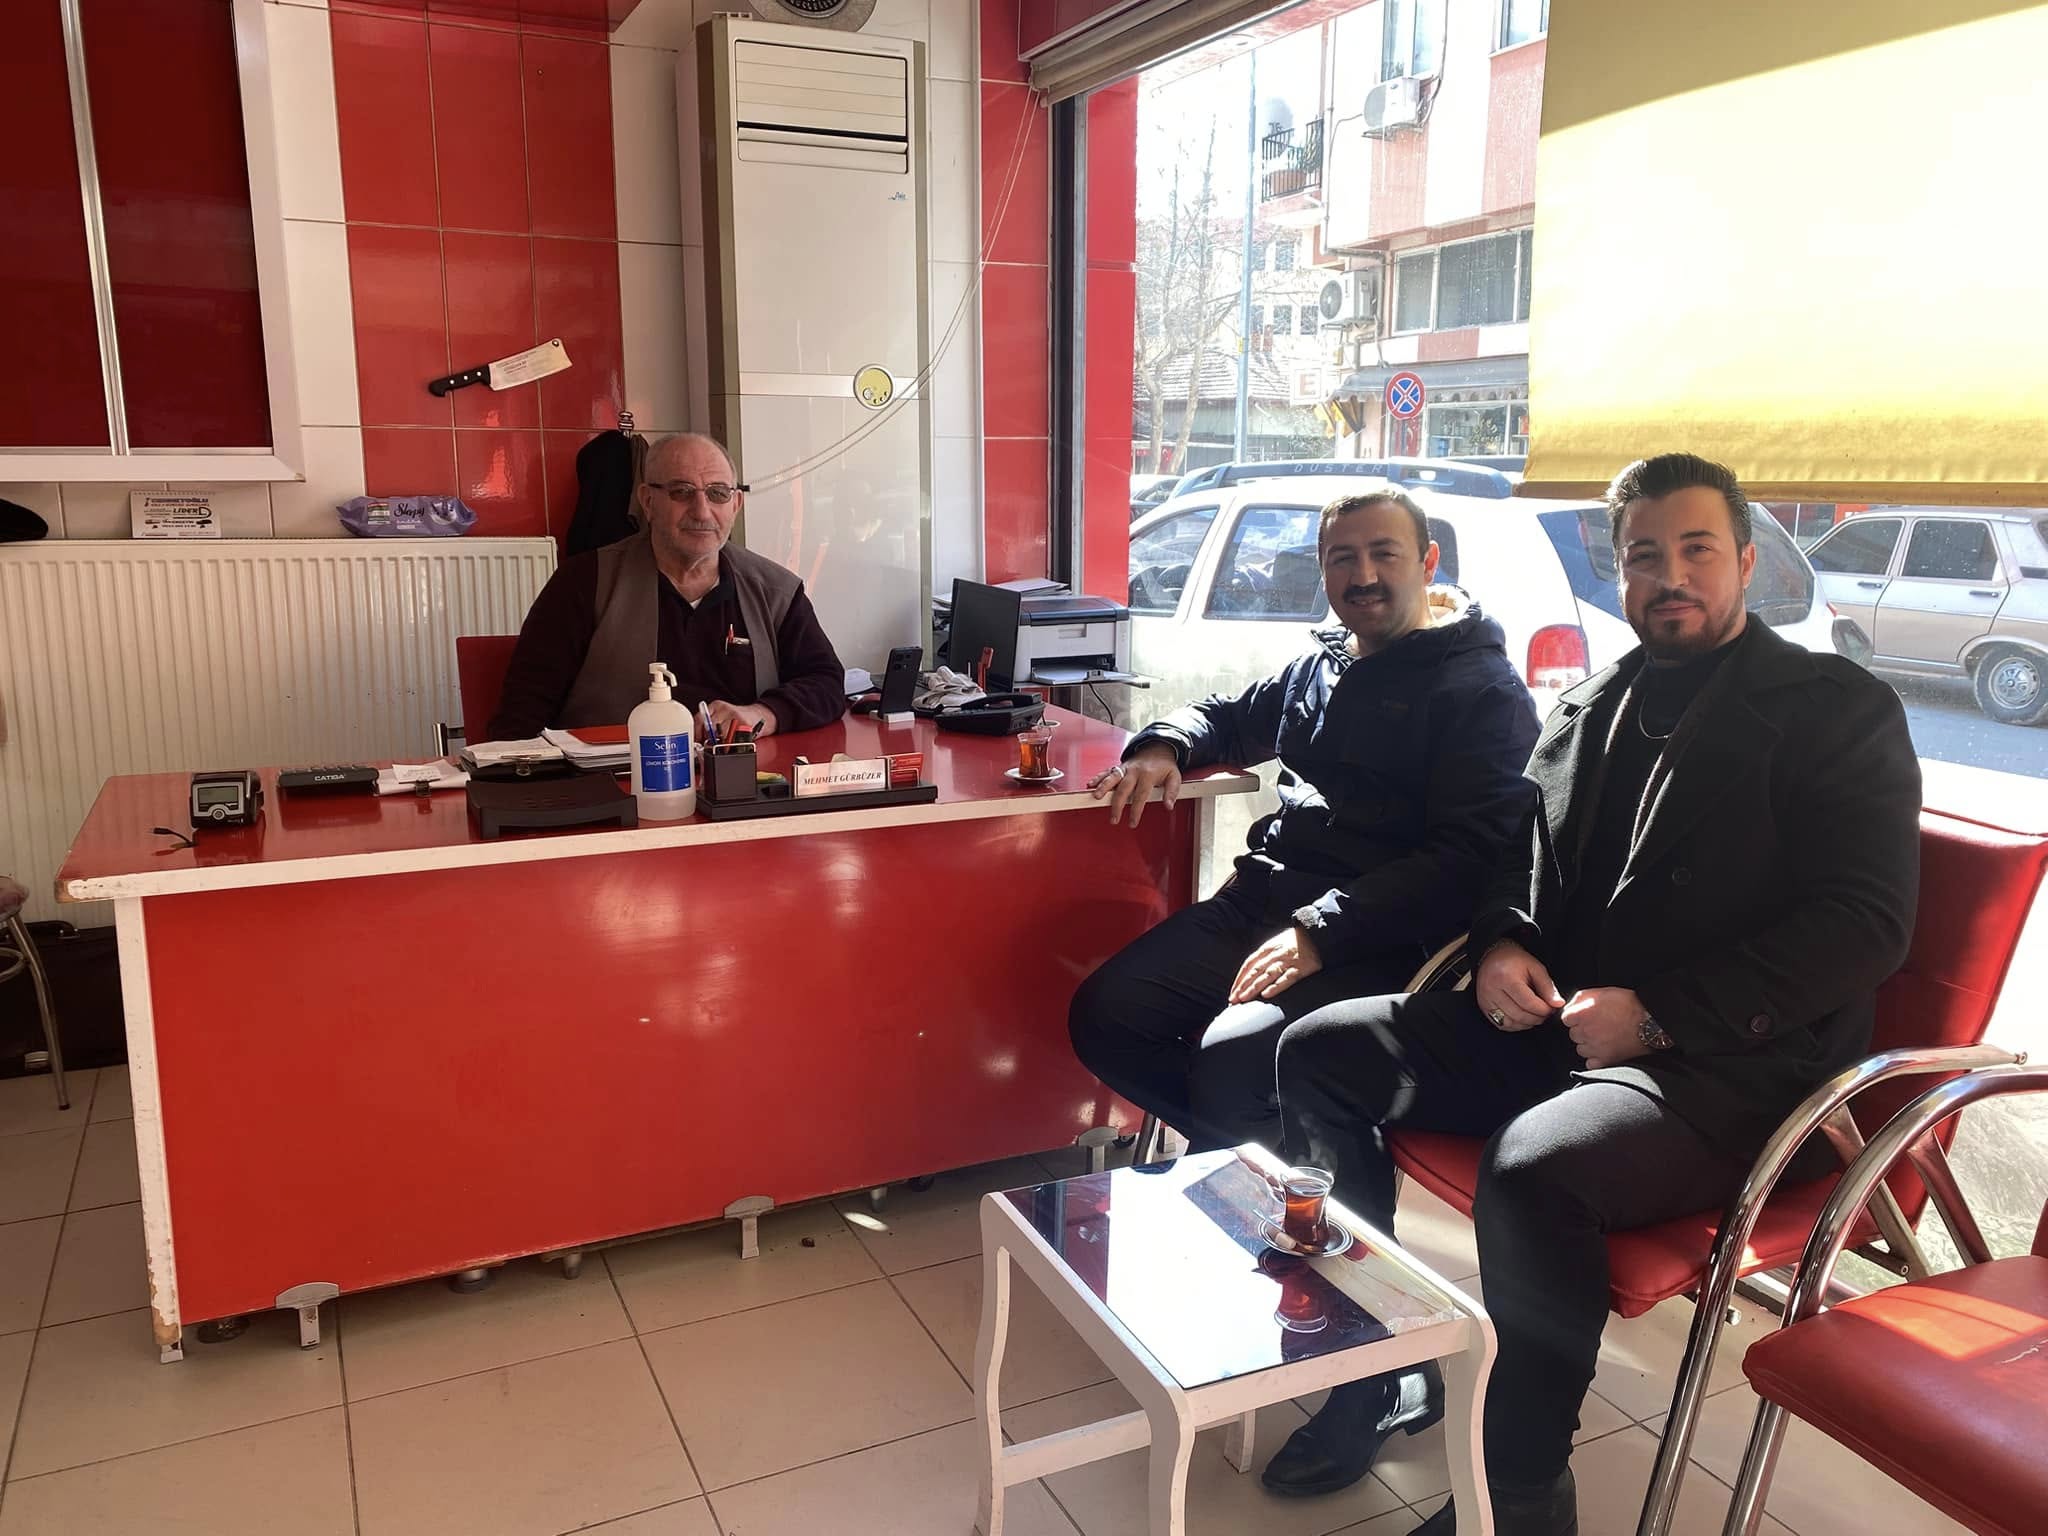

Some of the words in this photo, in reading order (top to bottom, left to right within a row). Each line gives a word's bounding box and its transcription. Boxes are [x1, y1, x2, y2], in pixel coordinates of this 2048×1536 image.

[1294, 463, 1383, 473] DUSTER
[393, 502, 425, 518] Sleepy
[654, 740, 677, 751] Selin
[803, 775, 838, 785] MEHMET
[839, 771, 882, 782] GÜRBÜZER
